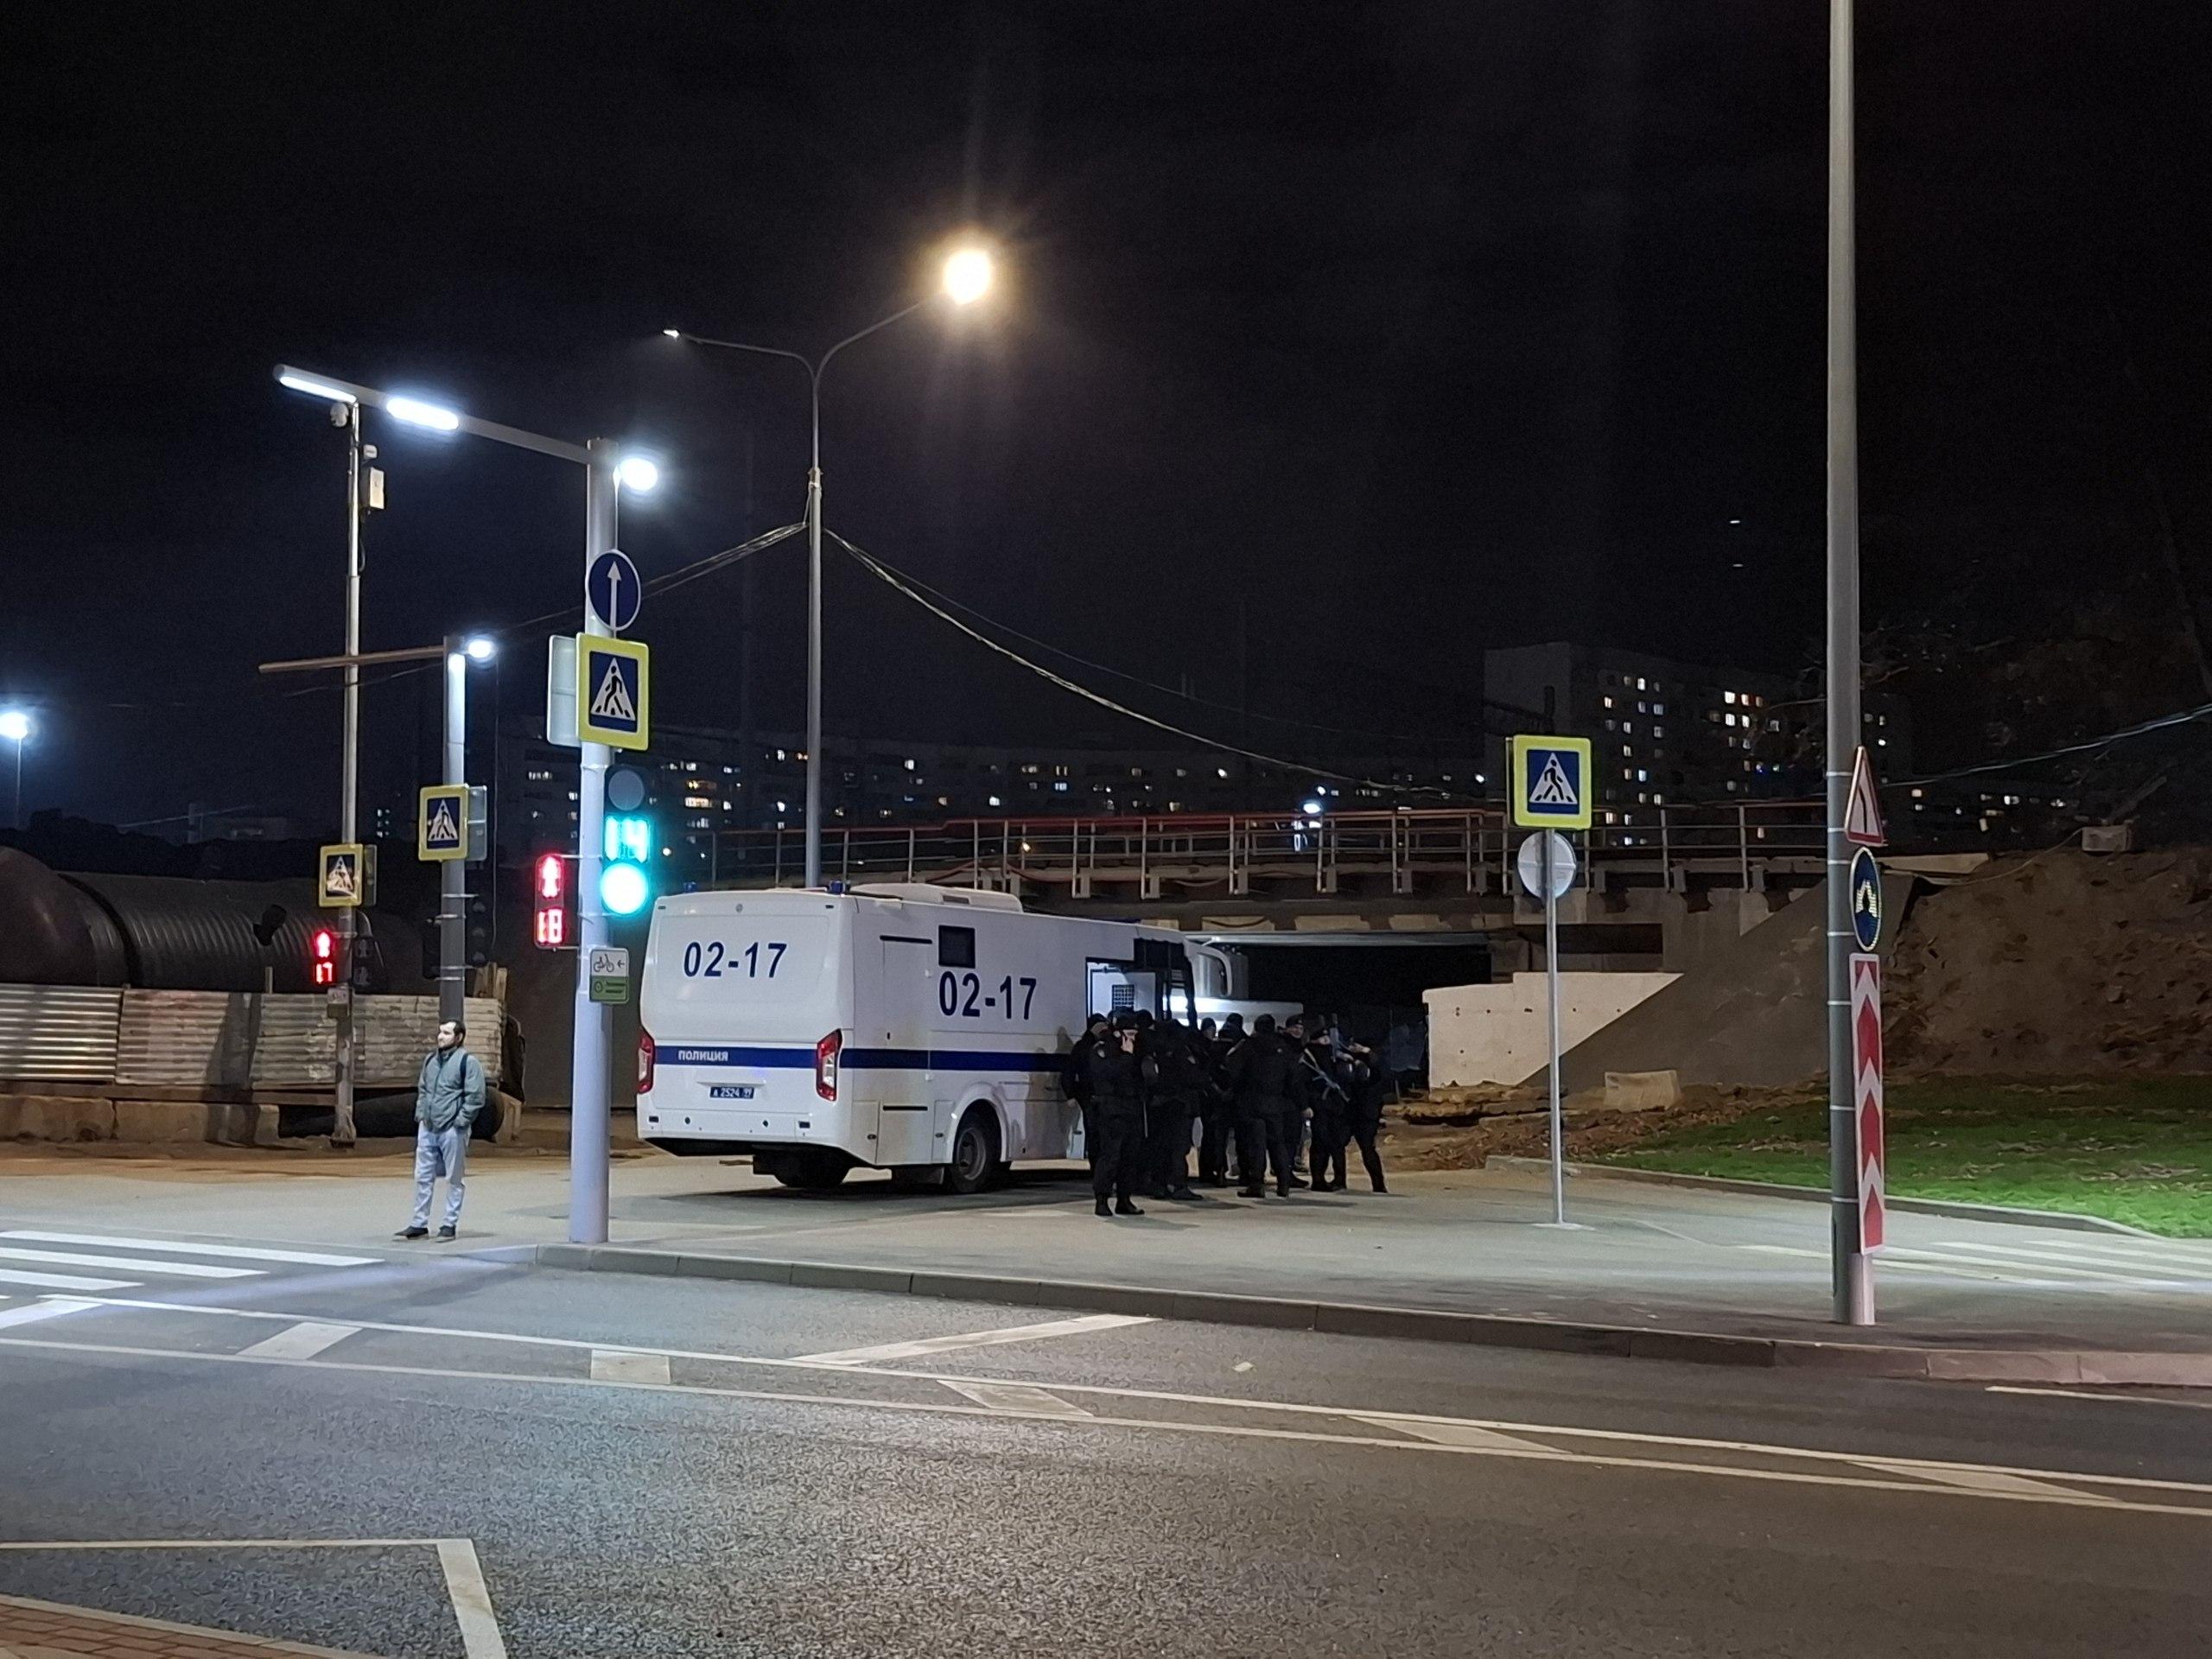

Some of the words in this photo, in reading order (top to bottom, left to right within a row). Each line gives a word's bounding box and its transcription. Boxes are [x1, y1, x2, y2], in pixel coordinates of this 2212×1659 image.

[683, 941, 787, 978] 02-17
[939, 970, 1037, 1020] 02-17
[677, 1050, 728, 1062] ПОЛИЦИЯ
